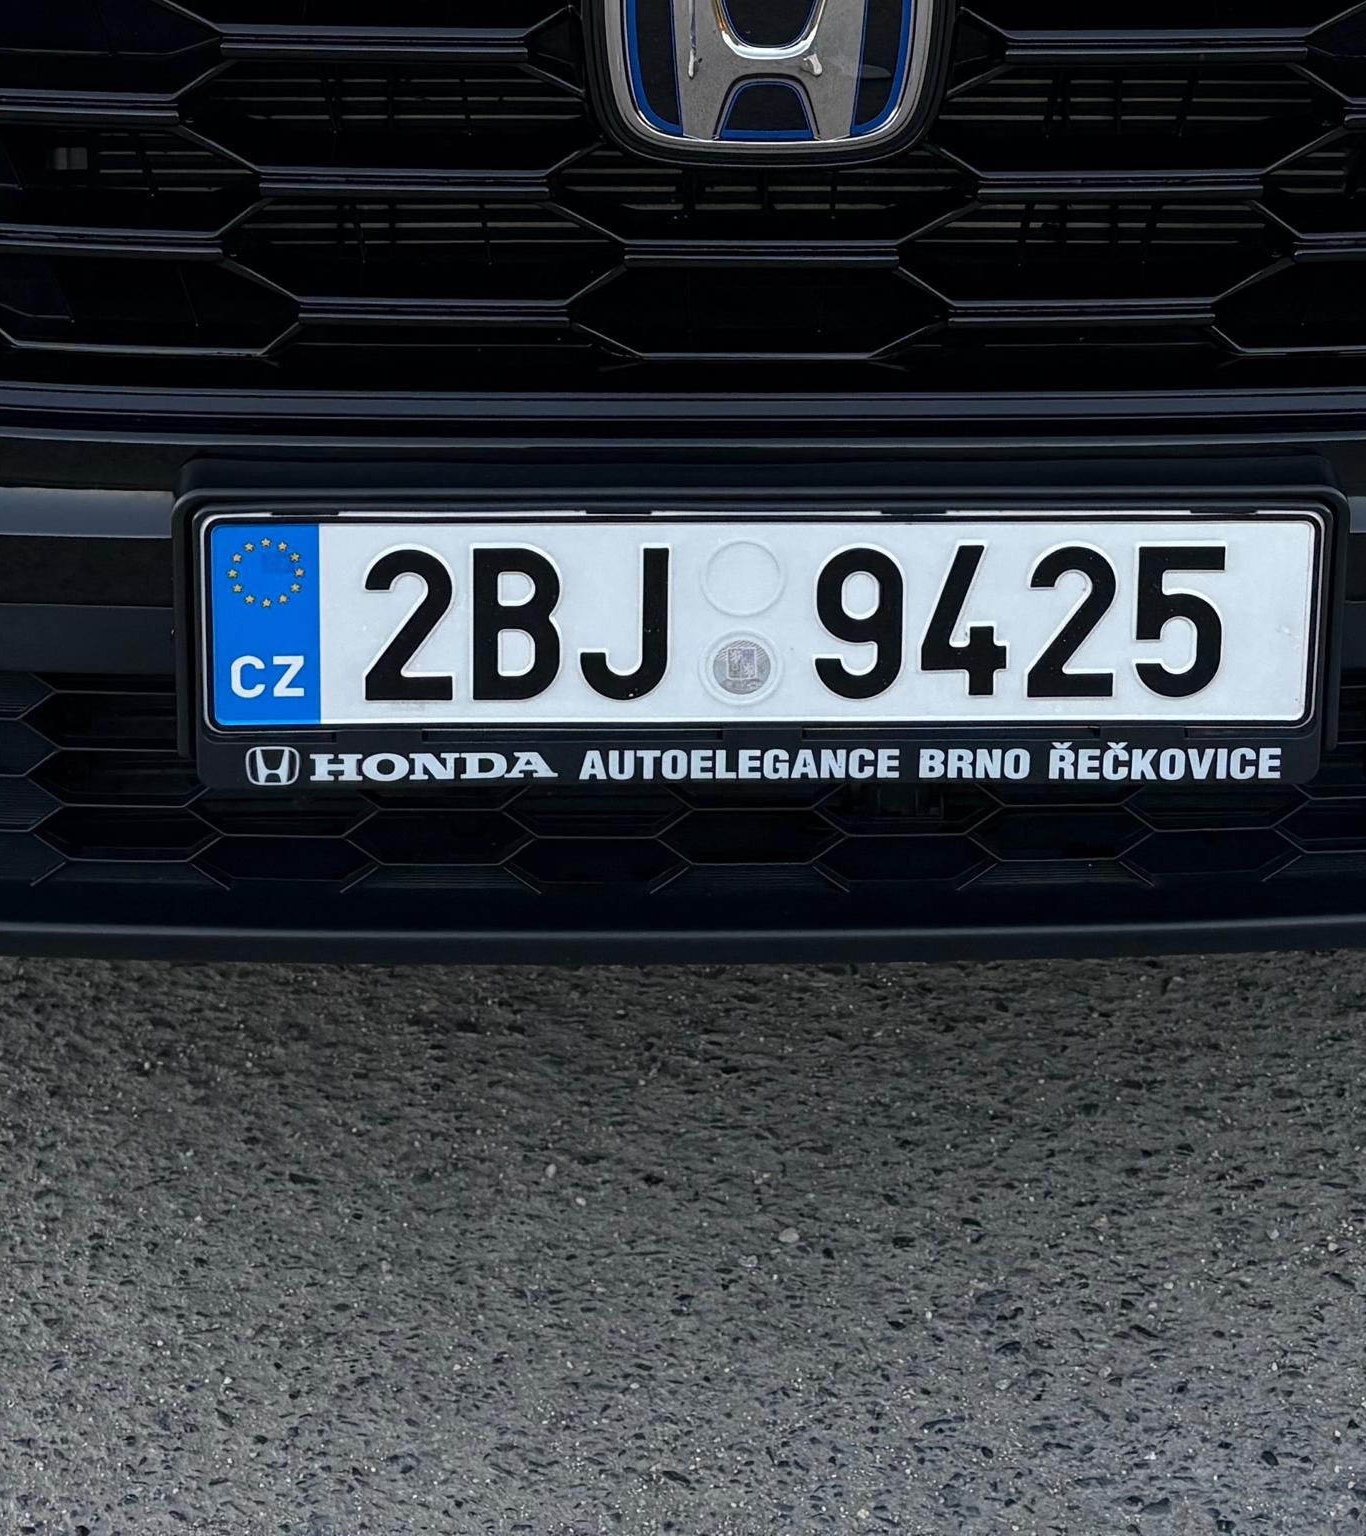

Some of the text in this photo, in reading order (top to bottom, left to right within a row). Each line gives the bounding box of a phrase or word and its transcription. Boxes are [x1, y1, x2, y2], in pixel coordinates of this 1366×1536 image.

[363, 544, 1227, 703] 2BJ 9425
[231, 655, 305, 699] CZ
[309, 751, 559, 782] HONDA
[579, 748, 900, 781] AUTOELEGANCE
[917, 748, 1032, 781] BRNO
[1048, 741, 1283, 780] ŘEČKOVICE
